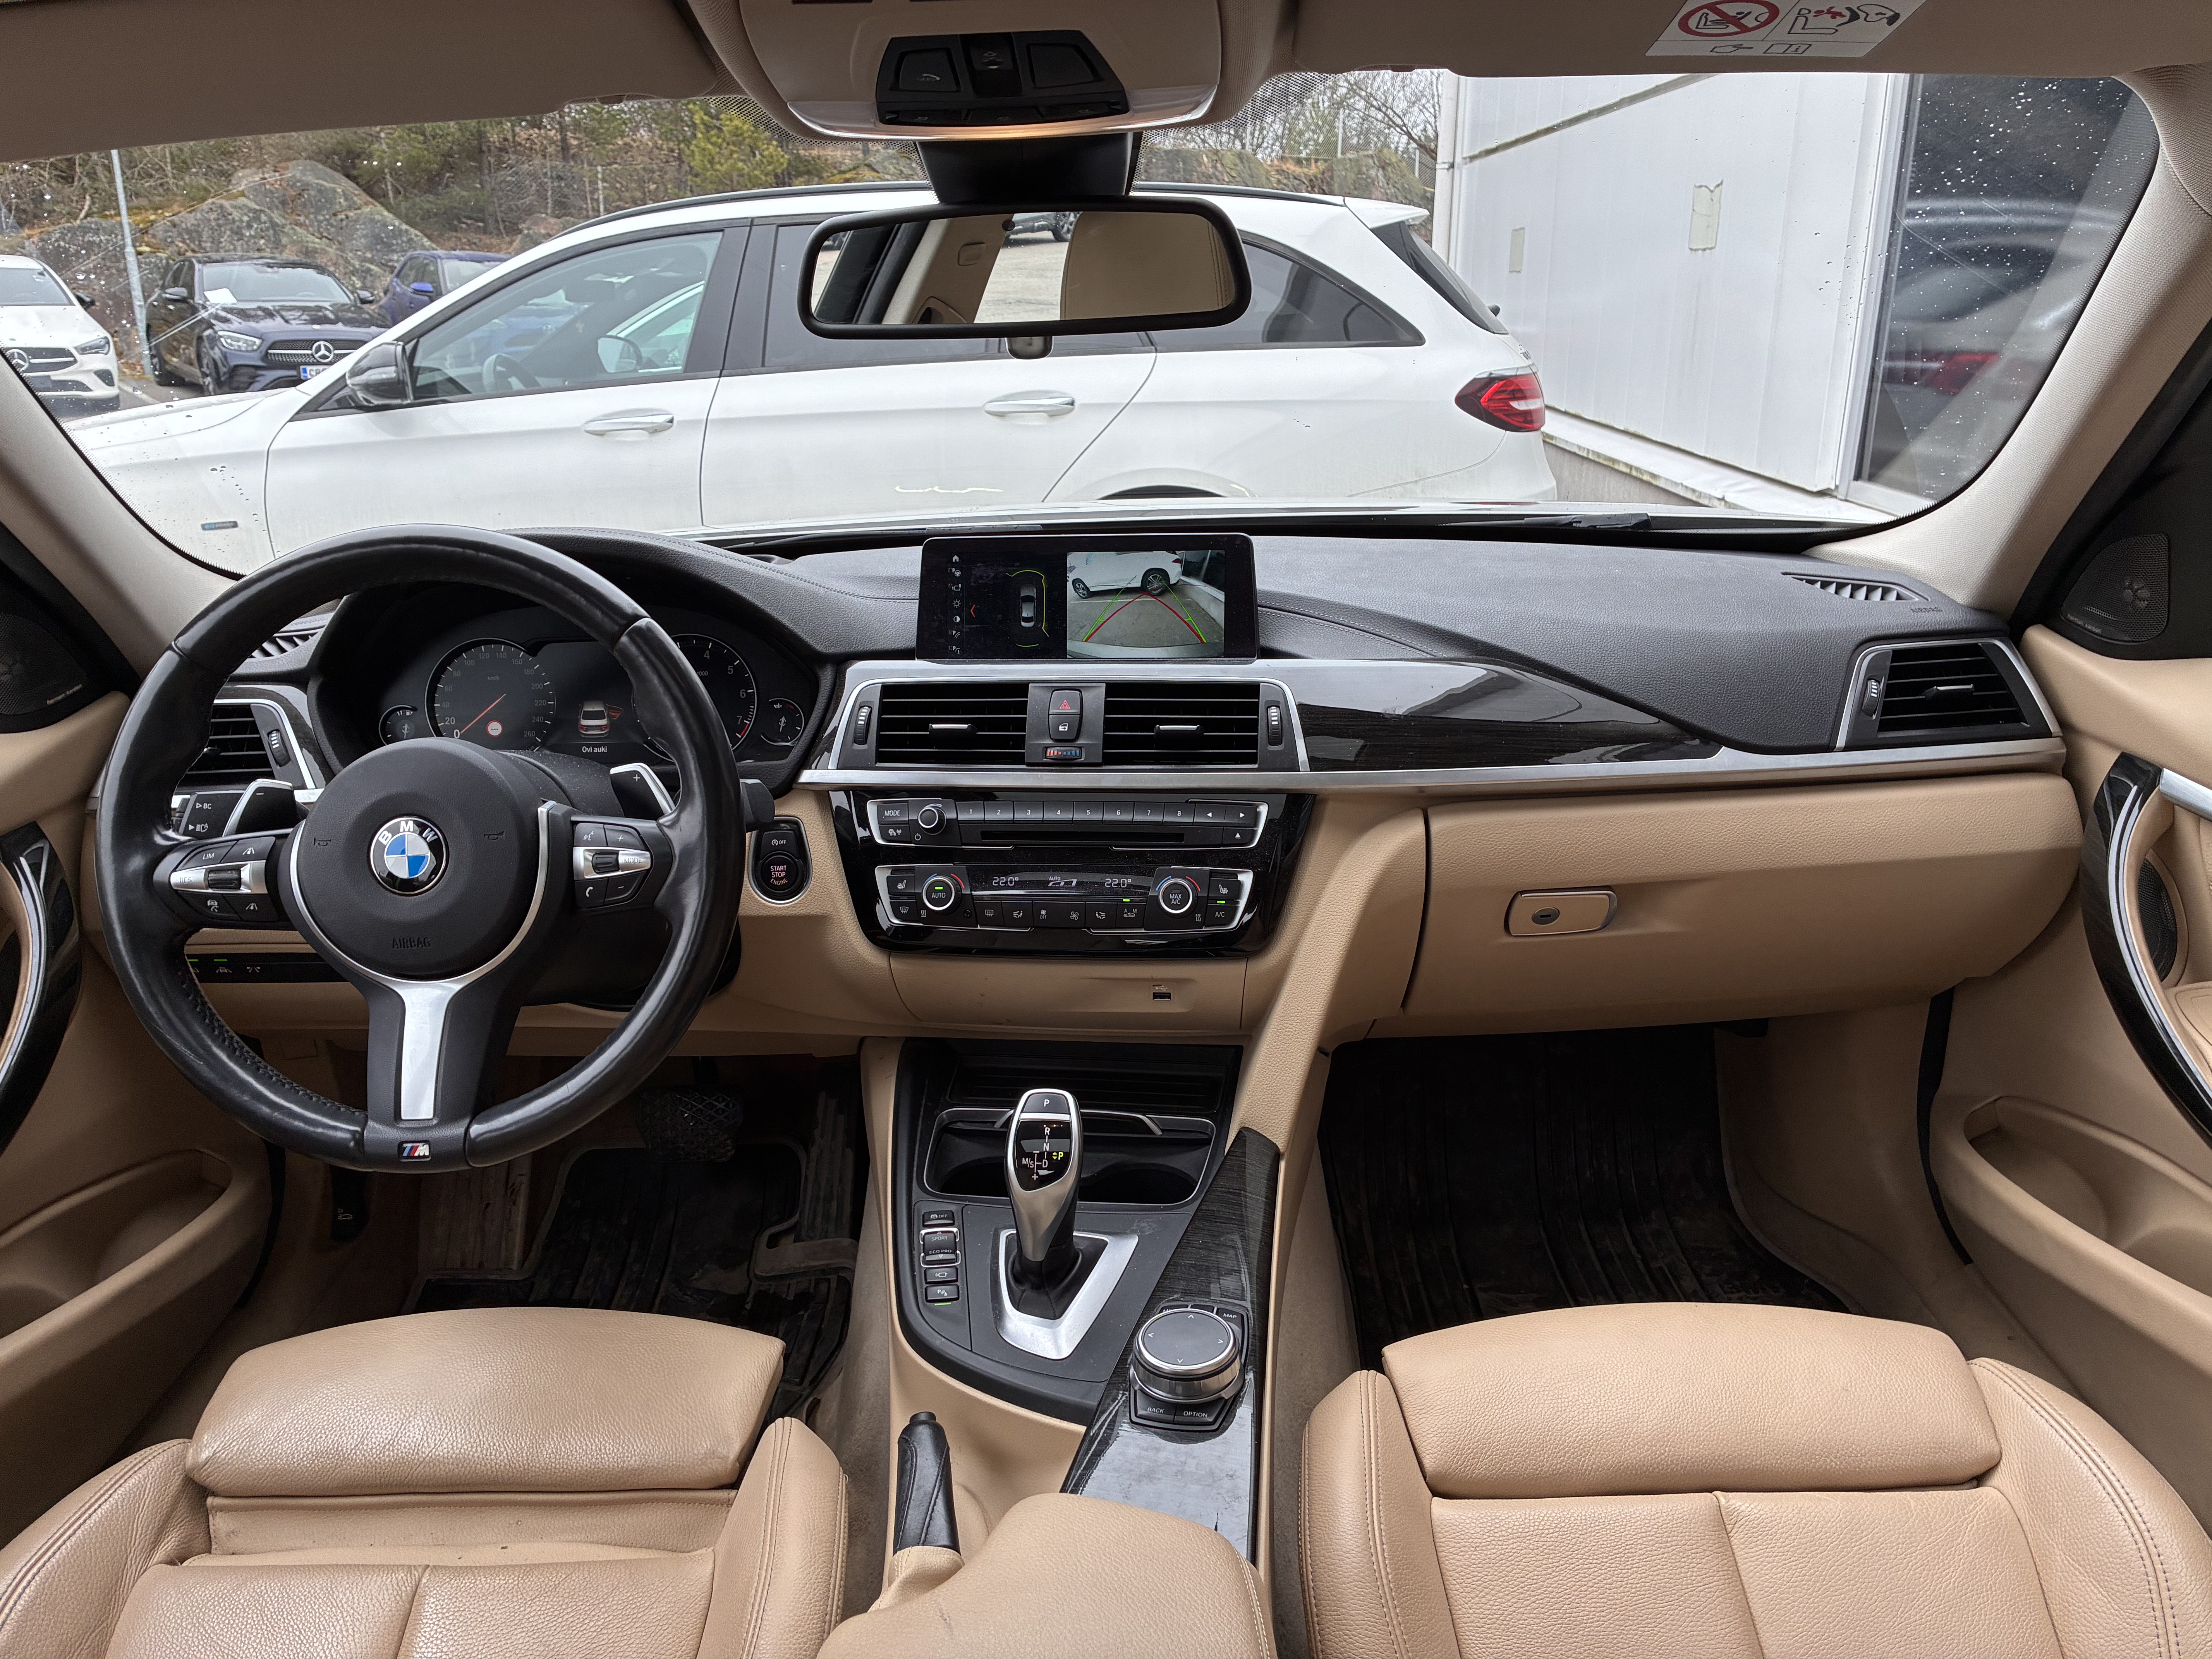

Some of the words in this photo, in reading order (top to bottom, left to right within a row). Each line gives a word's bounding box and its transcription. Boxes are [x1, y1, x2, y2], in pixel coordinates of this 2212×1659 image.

[704, 651, 710, 659] 4
[728, 666, 733, 674] 5
[740, 689, 746, 698] 6
[737, 716, 743, 725] 7
[453, 729, 460, 739] 0
[378, 820, 438, 845] BMW
[392, 937, 431, 949] AIRBAG
[1044, 1099, 1050, 1107] P
[1045, 1127, 1050, 1135] R
[1043, 1142, 1049, 1152] N
[1058, 1152, 1063, 1161] P
[1042, 1159, 1048, 1168] D
